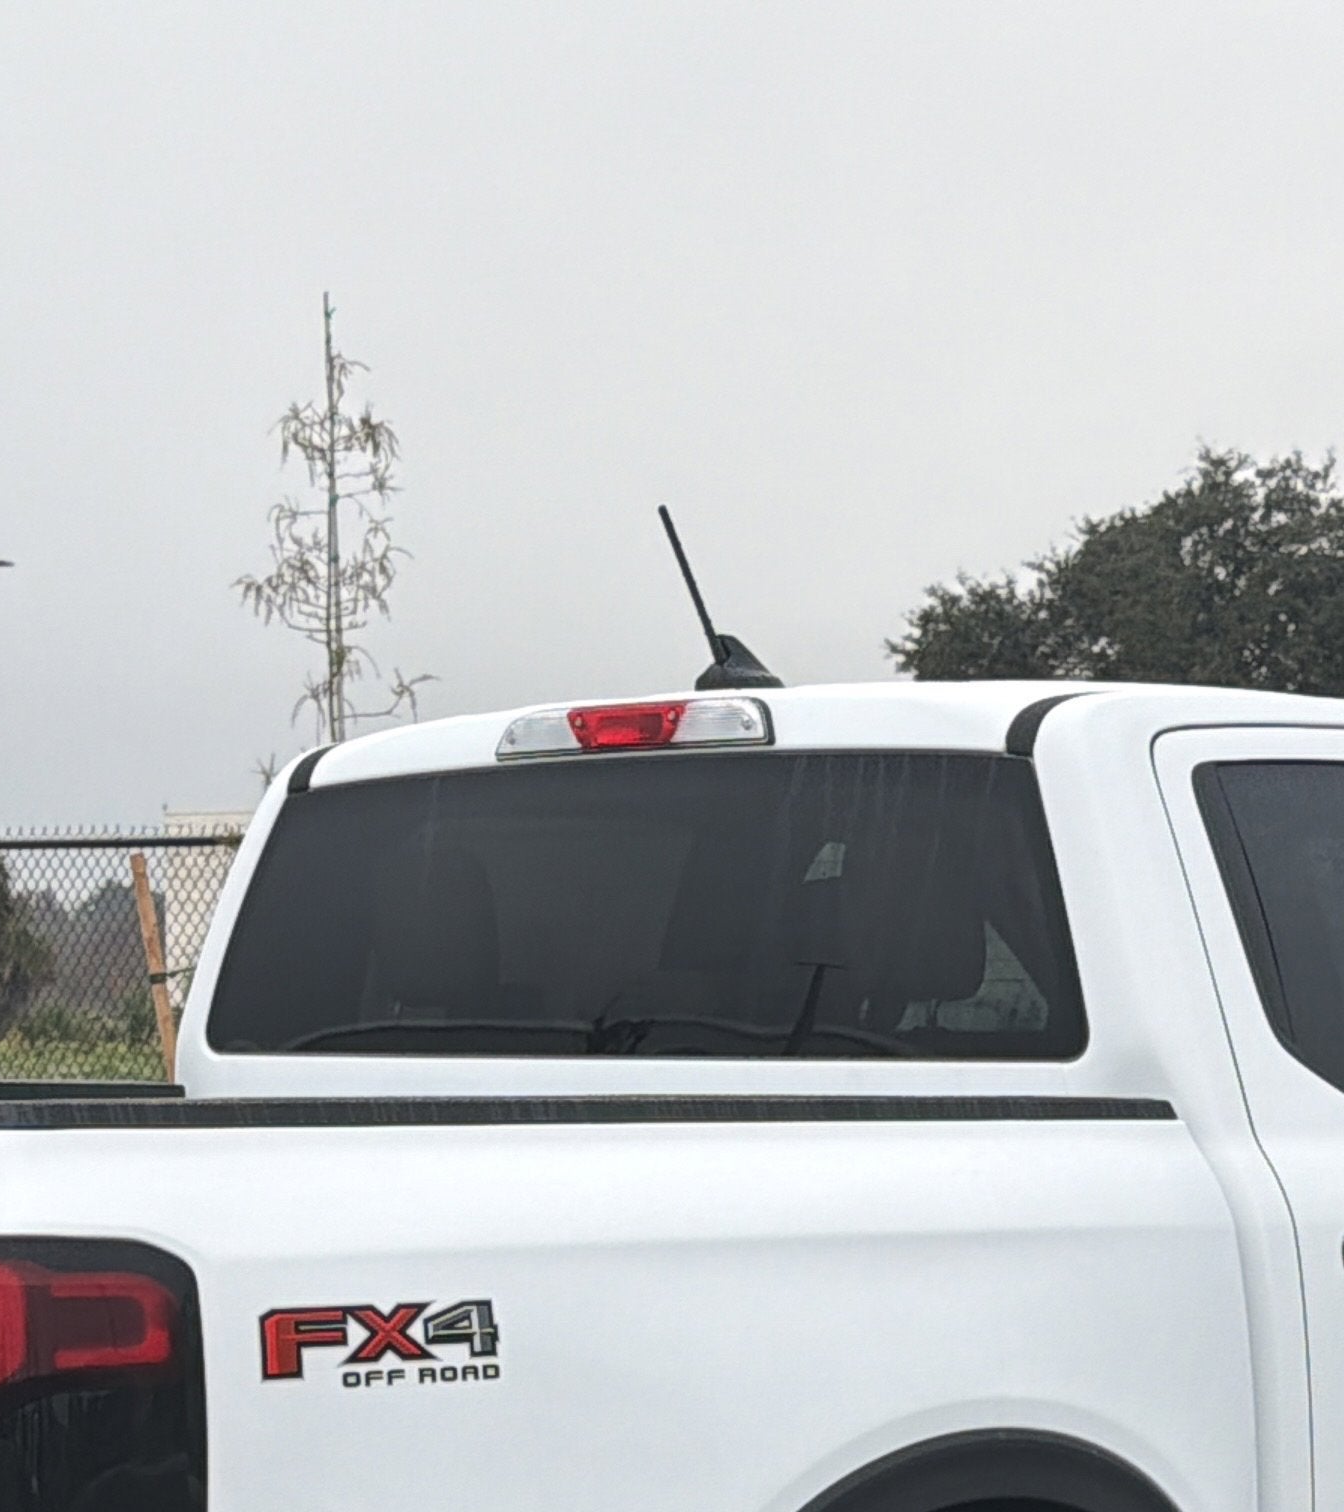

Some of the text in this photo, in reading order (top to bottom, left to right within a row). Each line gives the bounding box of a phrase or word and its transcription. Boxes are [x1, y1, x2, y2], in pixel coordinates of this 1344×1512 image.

[259, 1299, 499, 1382] FX4
[342, 1363, 500, 1388] OFF ROAD
